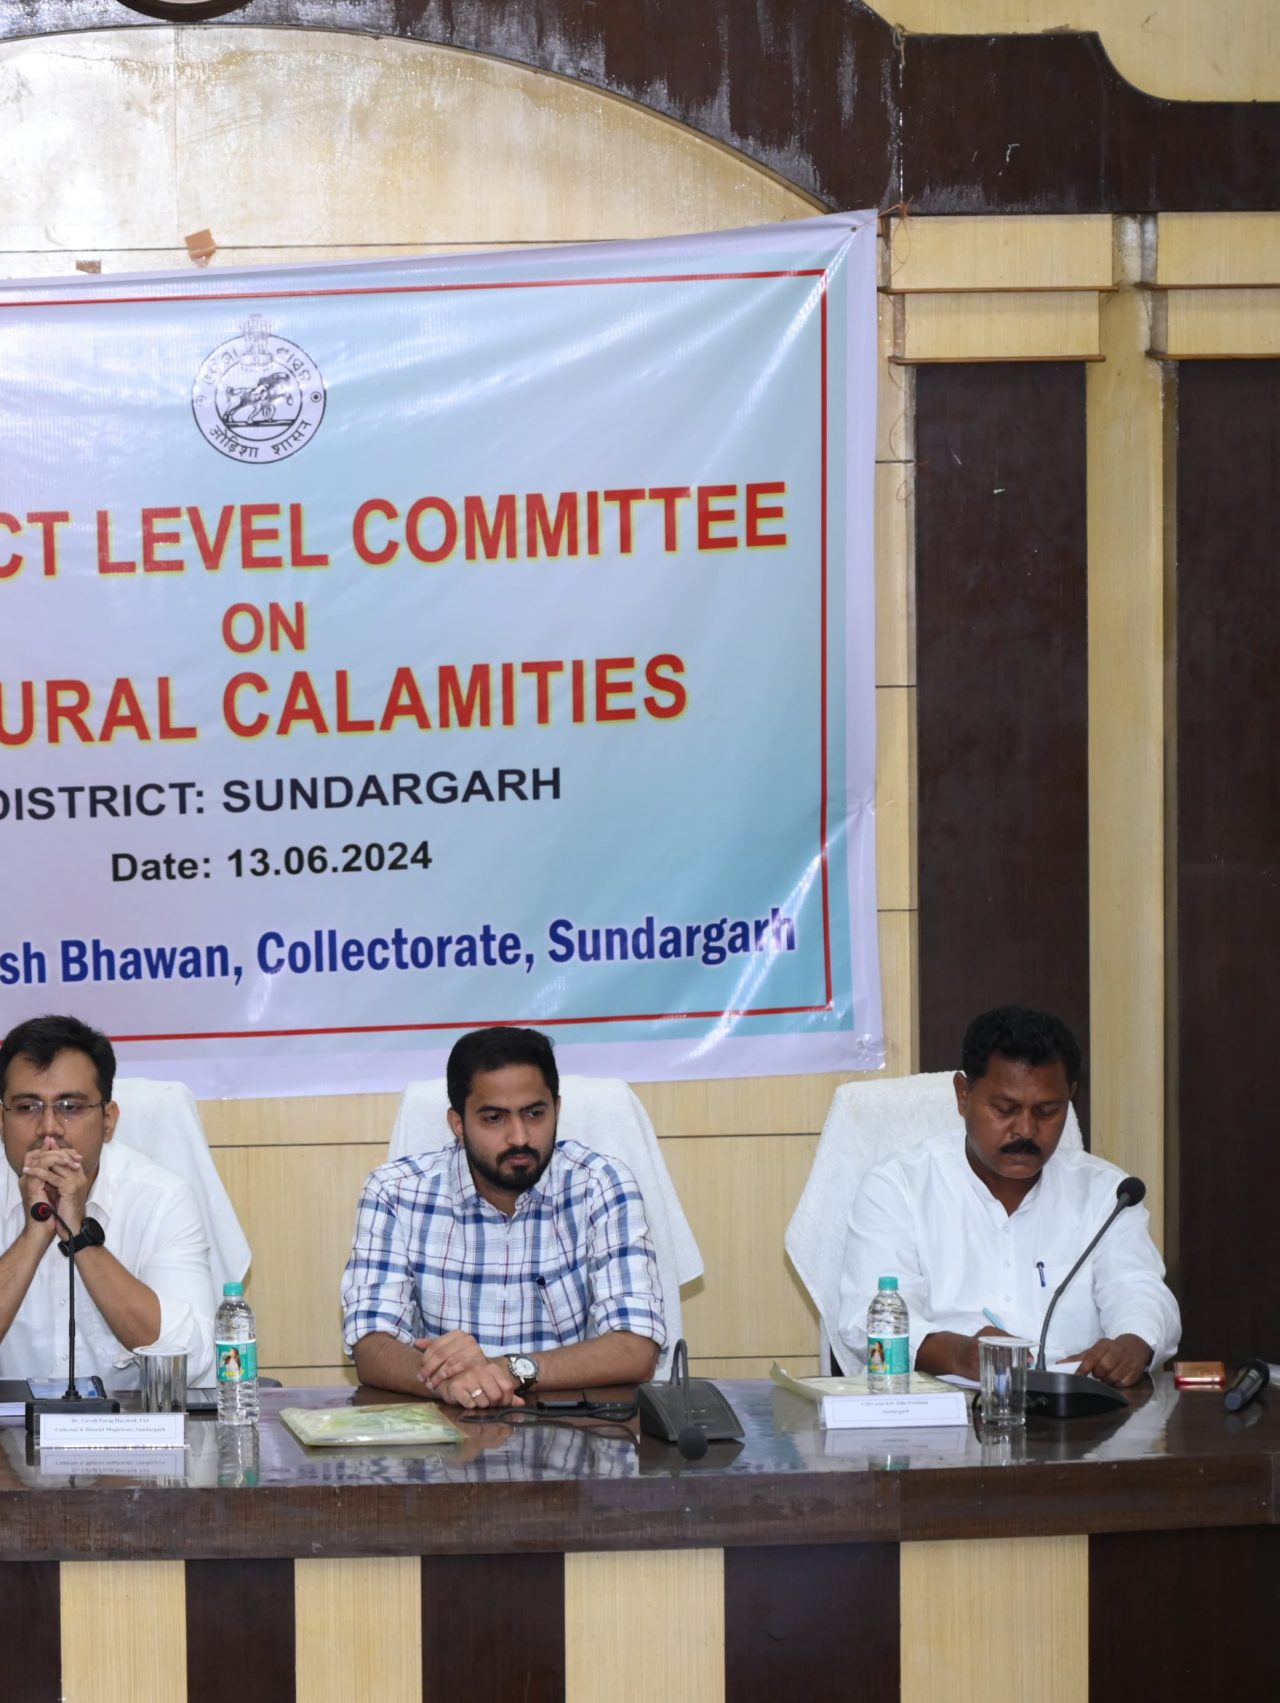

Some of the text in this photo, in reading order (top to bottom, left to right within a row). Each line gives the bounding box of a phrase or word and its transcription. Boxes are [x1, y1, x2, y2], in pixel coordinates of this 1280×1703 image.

[271, 419, 312, 455] शासन
[97, 503, 329, 574] LEVEL
[353, 481, 787, 565] COMMITTEE
[223, 602, 305, 653] ON
[223, 652, 687, 737] CALAMITIES
[222, 767, 561, 813] SUNDARGARH
[111, 840, 433, 882] Date: 13.06.2024
[60, 938, 243, 986] Bhawan,
[256, 923, 535, 975] Collectorate,
[547, 907, 796, 966] Sundargarh
